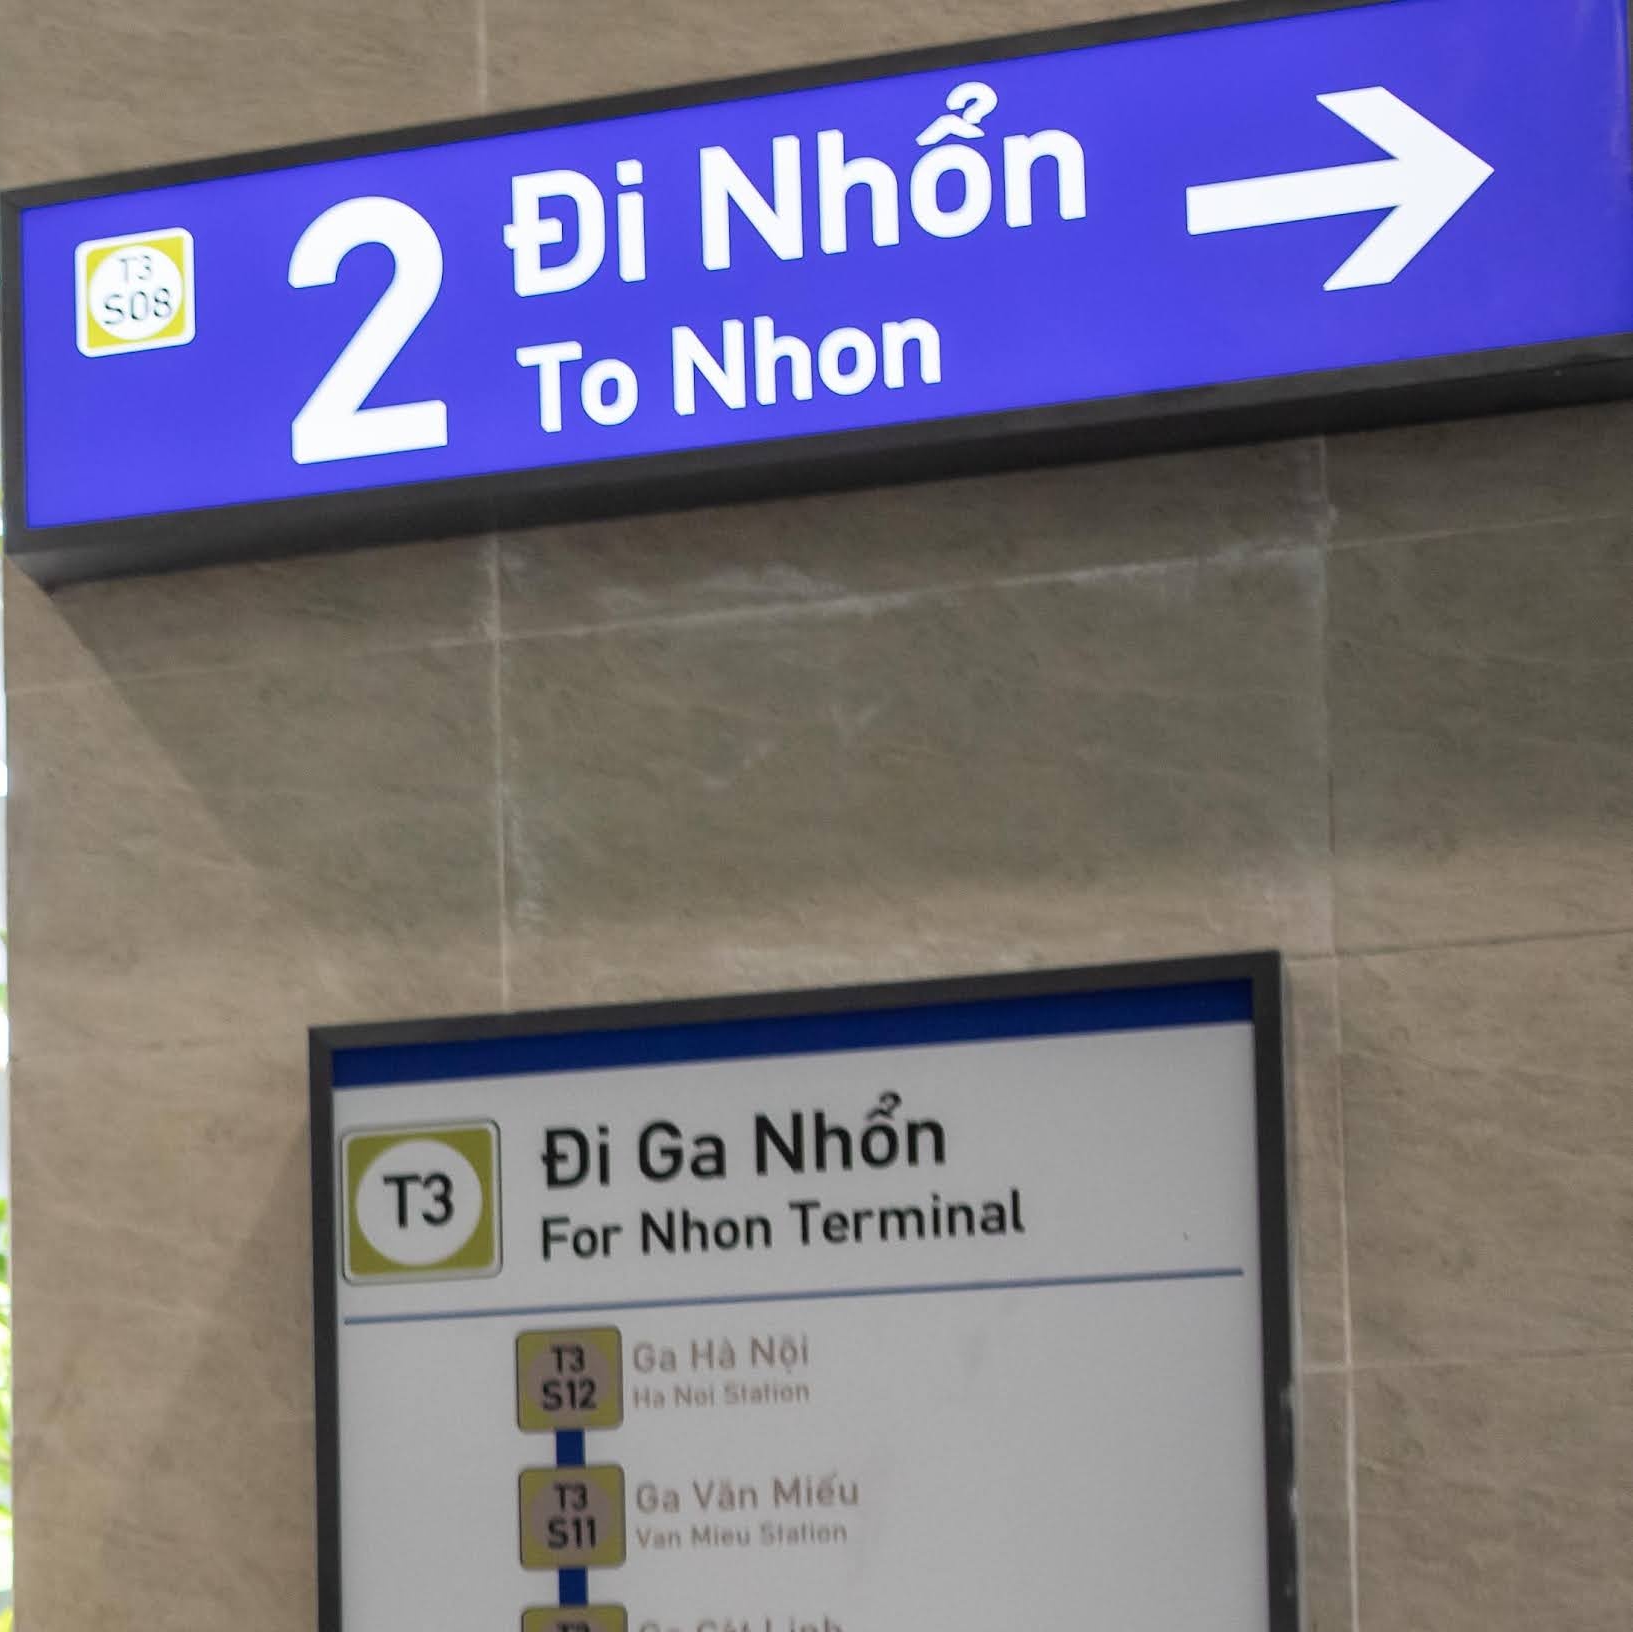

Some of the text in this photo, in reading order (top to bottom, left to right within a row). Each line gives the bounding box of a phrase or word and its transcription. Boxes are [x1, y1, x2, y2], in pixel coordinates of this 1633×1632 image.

[503, 82, 1086, 297] Đi Nhổn
[119, 255, 152, 283] T3
[104, 287, 172, 324] S08
[288, 196, 448, 464] 2
[516, 316, 942, 433] To Nhon
[540, 1091, 947, 1189] Đi Ga Nhổn
[383, 1172, 456, 1228] T3
[542, 1187, 1025, 1261] For Nhon Terminal
[551, 1344, 584, 1374] T3
[633, 1334, 809, 1374] Ga Hà Nội
[542, 1380, 597, 1411] S12
[634, 1382, 809, 1410] Ha Noi Station
[554, 1483, 588, 1511] T3
[636, 1483, 680, 1513] Ga
[548, 1519, 596, 1549] S11
[636, 1523, 847, 1549] Van Mieu Station
